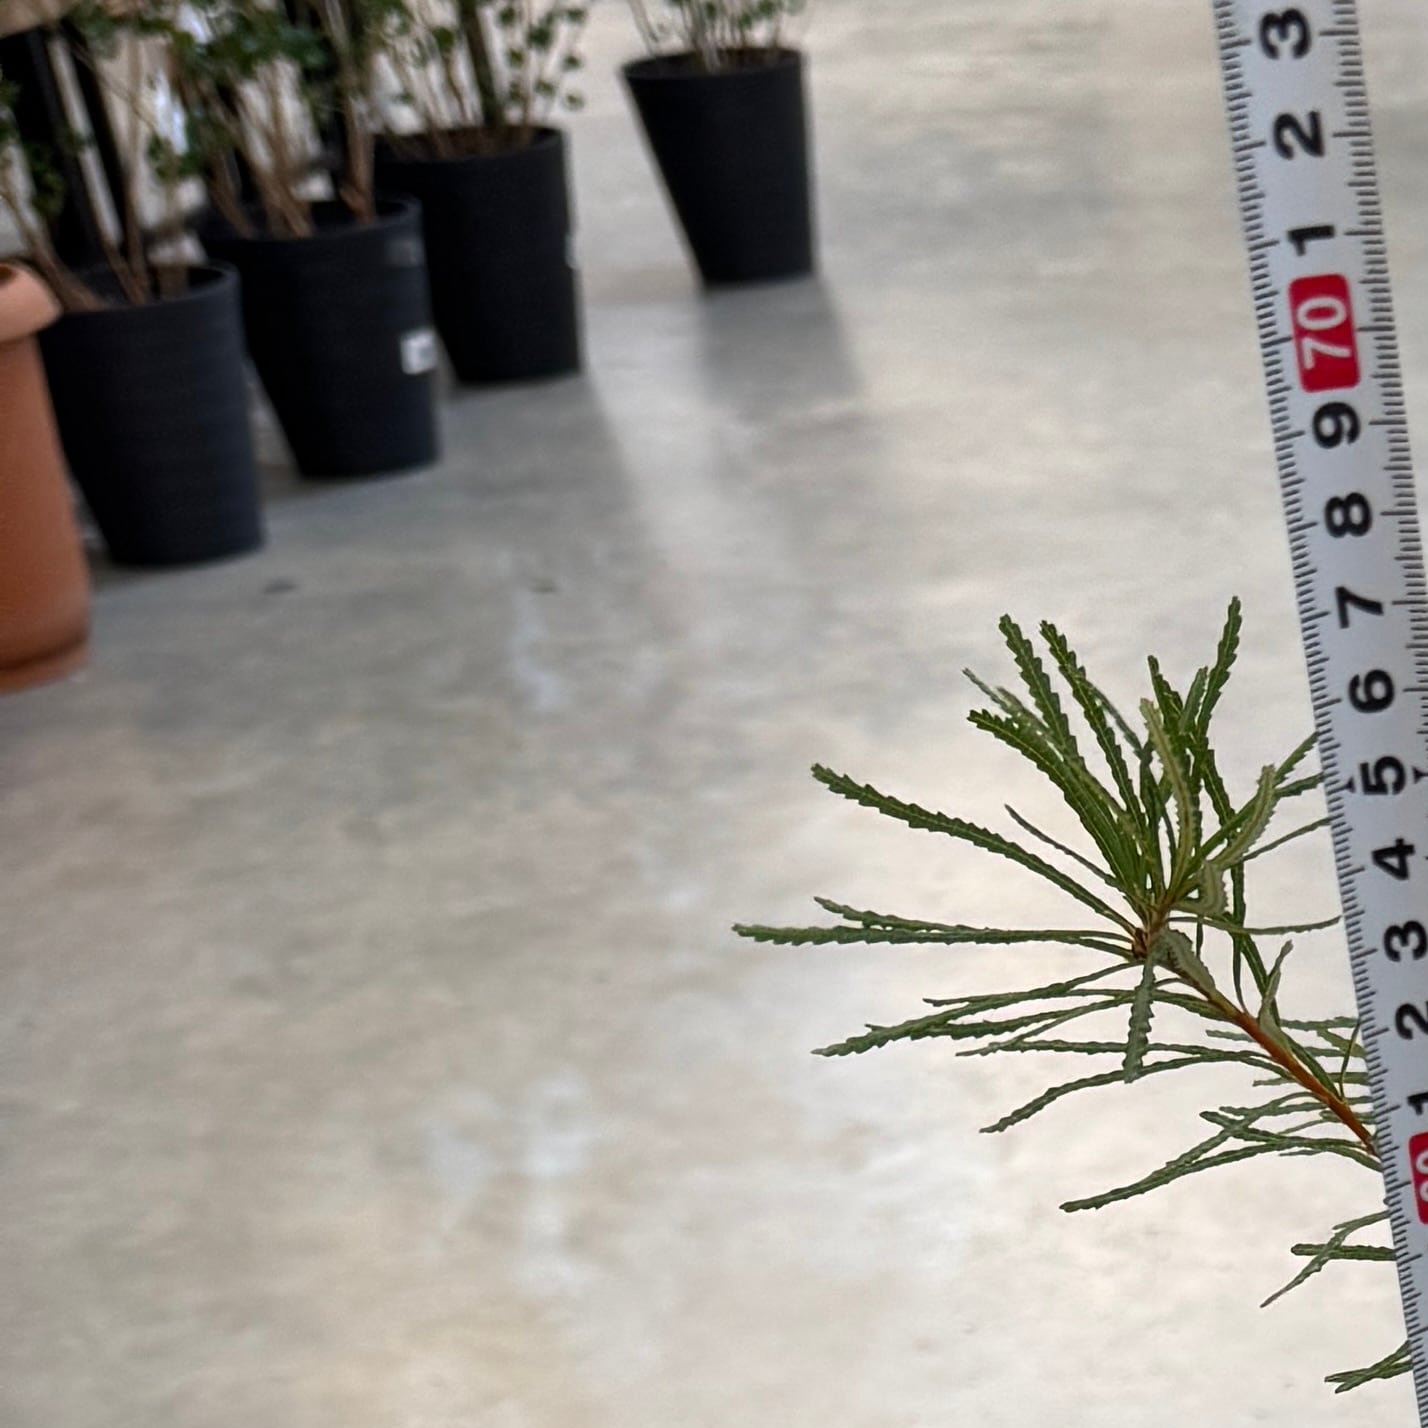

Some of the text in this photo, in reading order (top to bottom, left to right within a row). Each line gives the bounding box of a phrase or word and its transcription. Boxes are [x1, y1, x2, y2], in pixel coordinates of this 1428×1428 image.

[1259, 8, 1311, 59] 3
[1273, 111, 1324, 159] 2
[1288, 225, 1335, 255] 1
[1296, 297, 1350, 369] 70
[1312, 402, 1361, 448] 9
[1325, 492, 1372, 538] 8
[1335, 587, 1383, 628] 7
[1349, 670, 1395, 713] 6
[1360, 756, 1406, 795] 5
[1372, 838, 1415, 880] 4
[1384, 920, 1428, 961] 3
